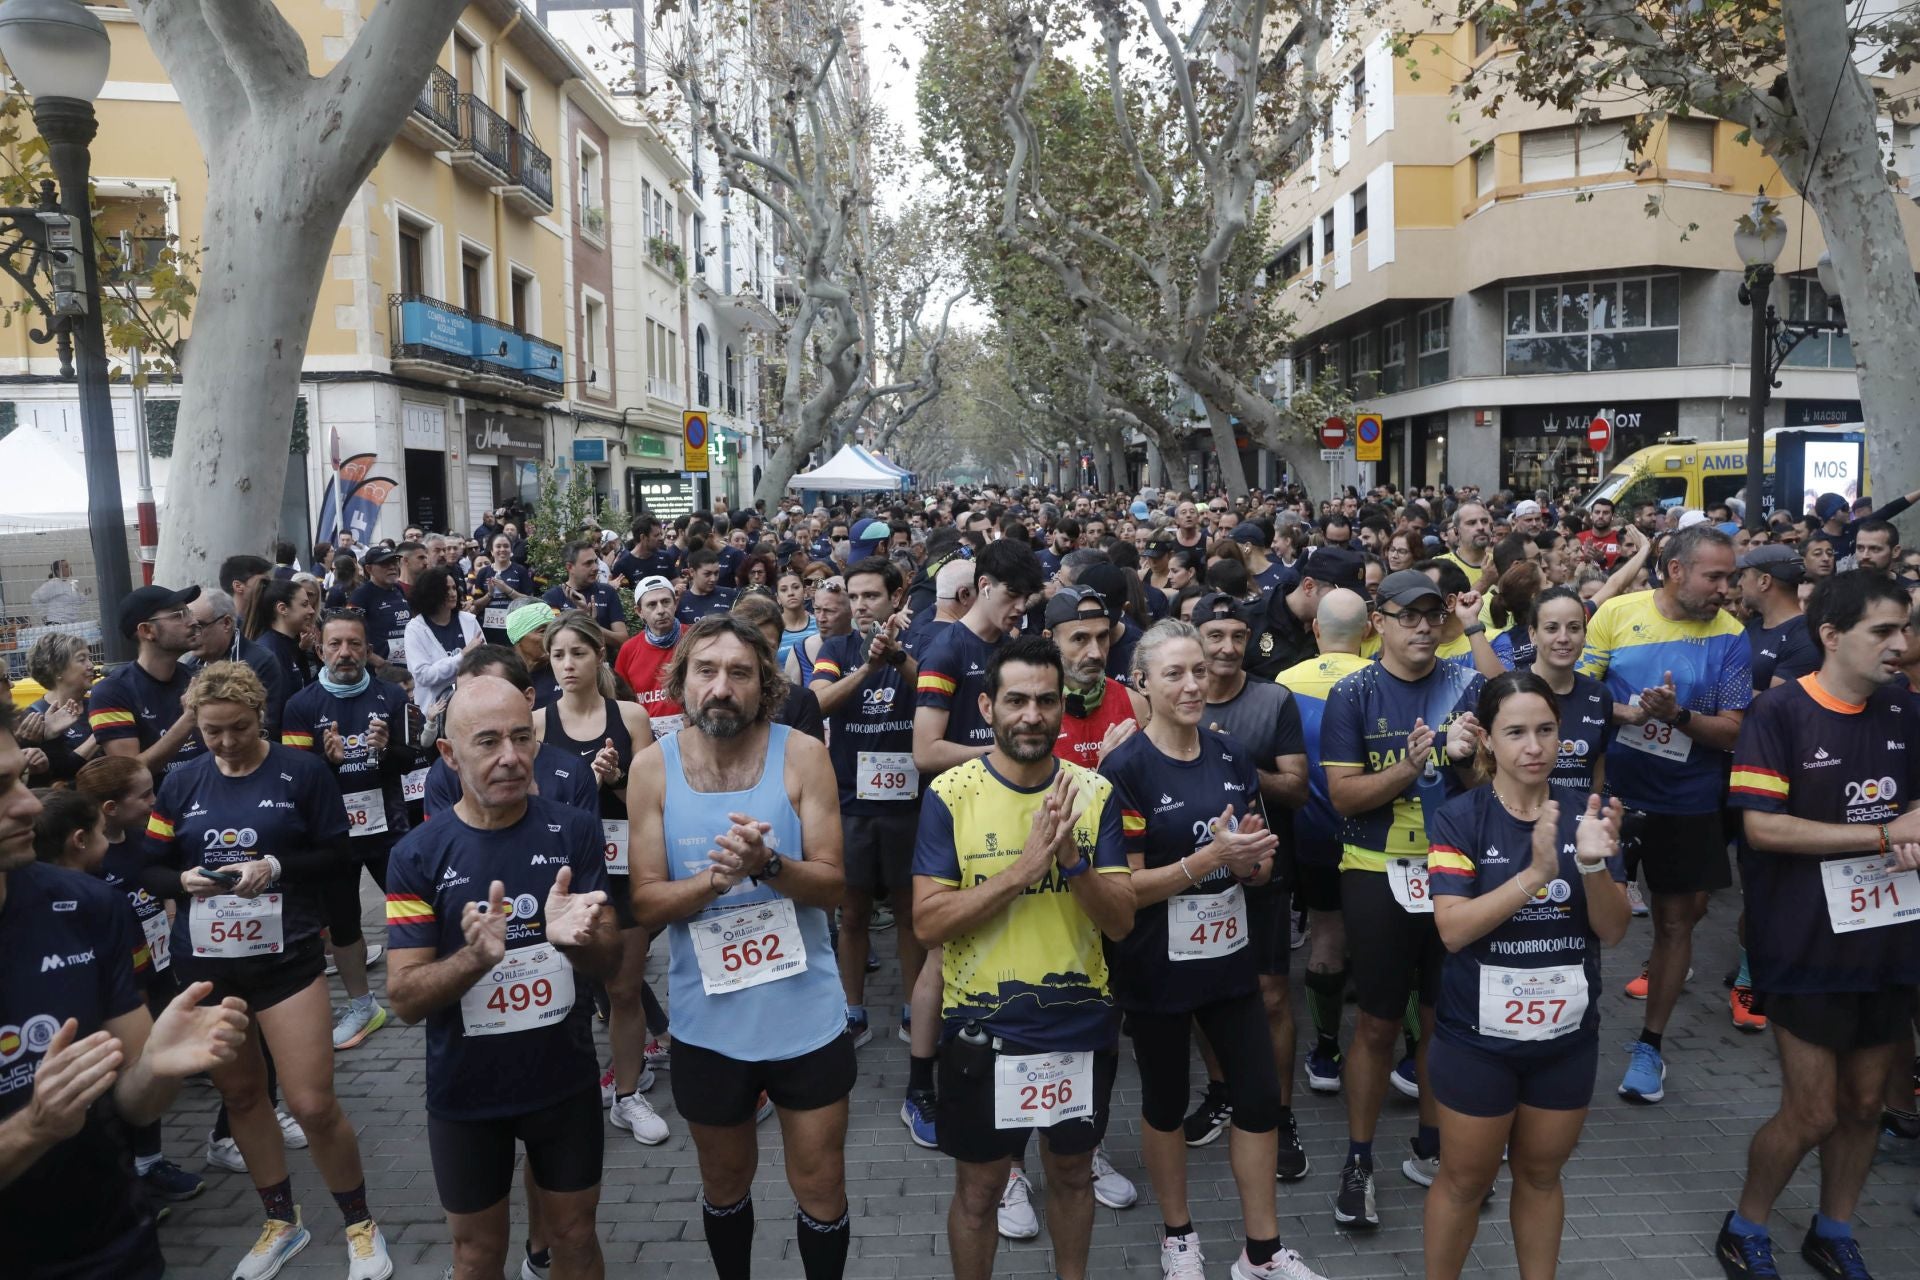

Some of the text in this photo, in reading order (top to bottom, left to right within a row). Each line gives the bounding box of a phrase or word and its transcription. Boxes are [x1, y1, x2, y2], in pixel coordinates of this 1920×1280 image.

[1566, 413, 1642, 429] MAON
[1813, 411, 1847, 420] MACSON
[1814, 461, 1847, 478] MOS
[1803, 758, 1843, 769] Santander
[871, 773, 906, 789] 439
[1845, 776, 1897, 806] 200
[183, 808, 208, 818] Santander
[1153, 801, 1185, 815] Santander
[1847, 804, 1889, 816] POLICIA
[1847, 809, 1899, 823] NACIONAL
[203, 828, 258, 850] 200
[1006, 849, 1023, 857] Dénia
[436, 876, 470, 893] Santander
[1410, 879, 1430, 899] 3
[1851, 881, 1900, 913] 511
[1512, 912, 1571, 922] NACIONAL
[211, 920, 263, 943] 542
[1190, 917, 1237, 945] 478
[722, 934, 784, 972] 562
[487, 979, 552, 1014] 499
[1505, 999, 1566, 1025] 257
[1020, 1079, 1073, 1110] 256
